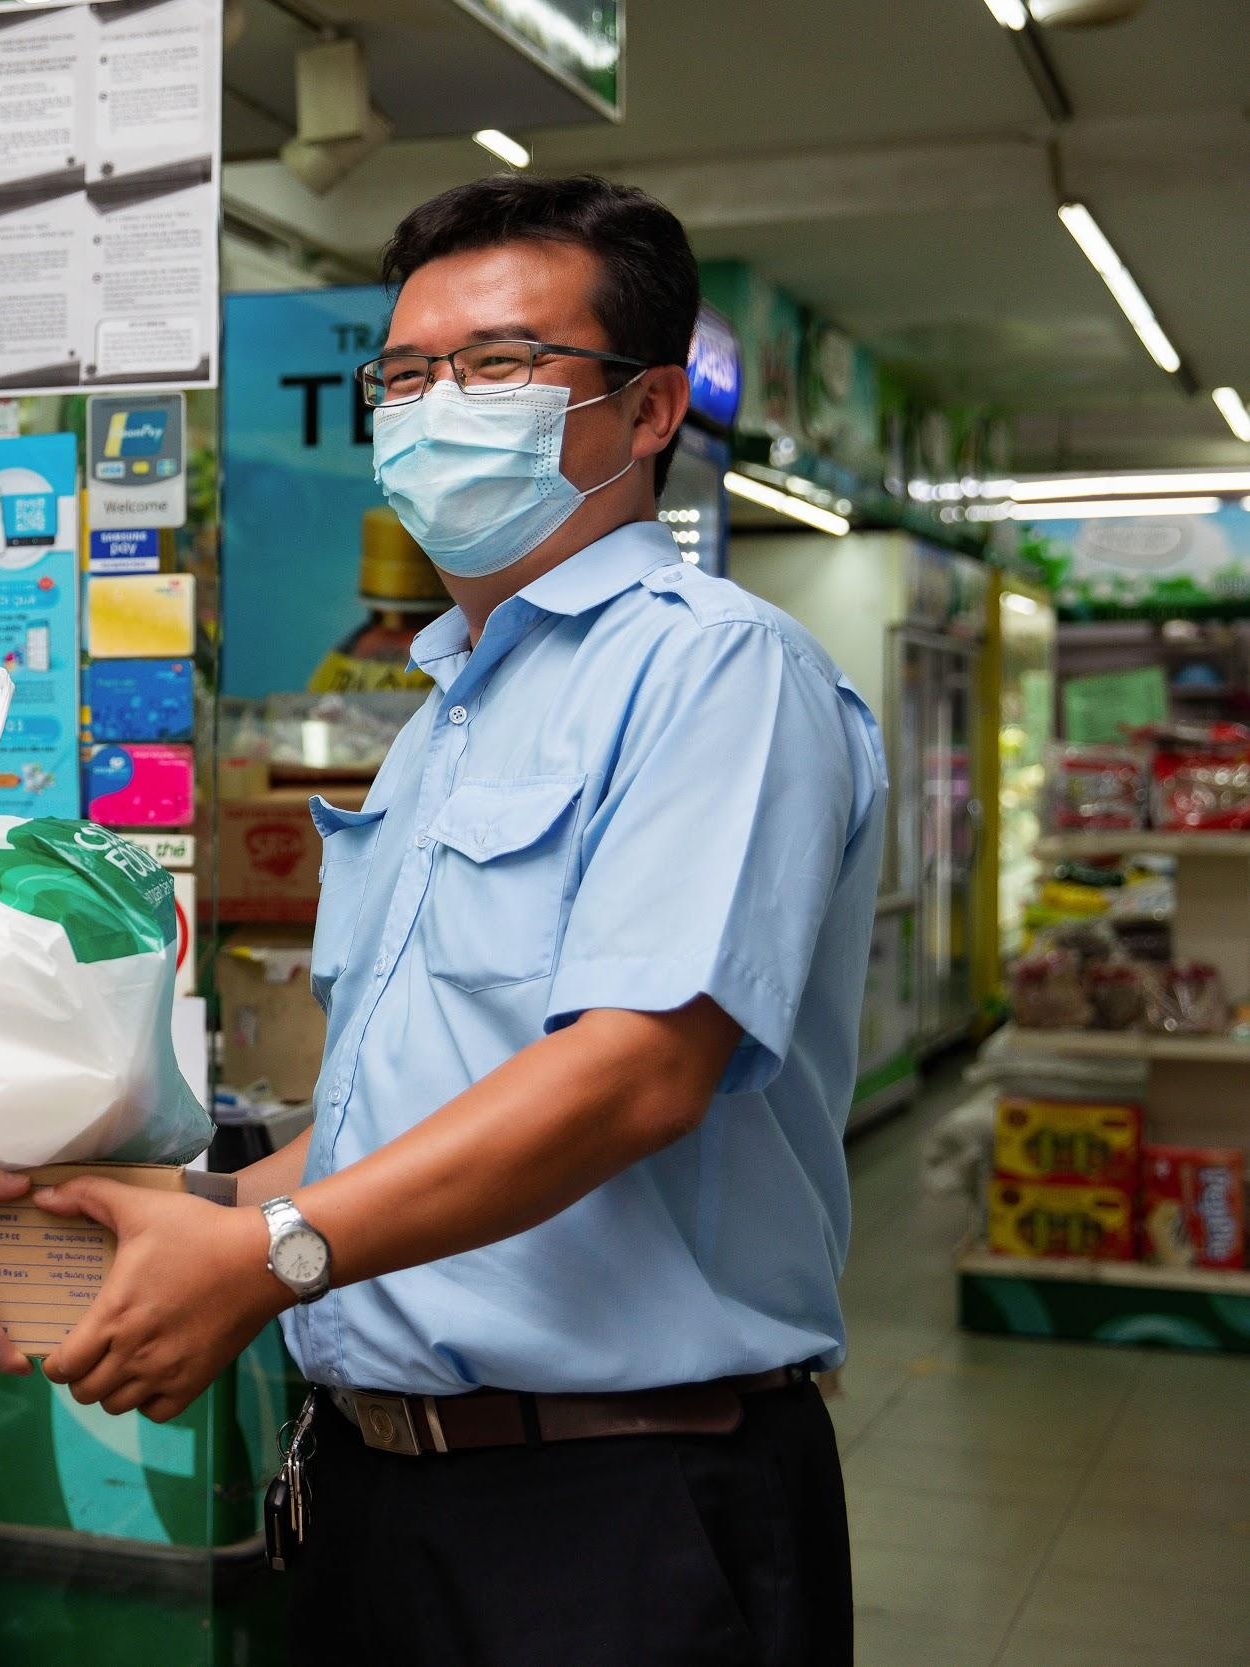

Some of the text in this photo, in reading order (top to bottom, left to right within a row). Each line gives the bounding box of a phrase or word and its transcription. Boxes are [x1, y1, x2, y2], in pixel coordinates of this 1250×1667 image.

[104, 500, 169, 515] Welcome
[100, 531, 148, 544] SAMSUNG
[109, 543, 138, 557] pay
